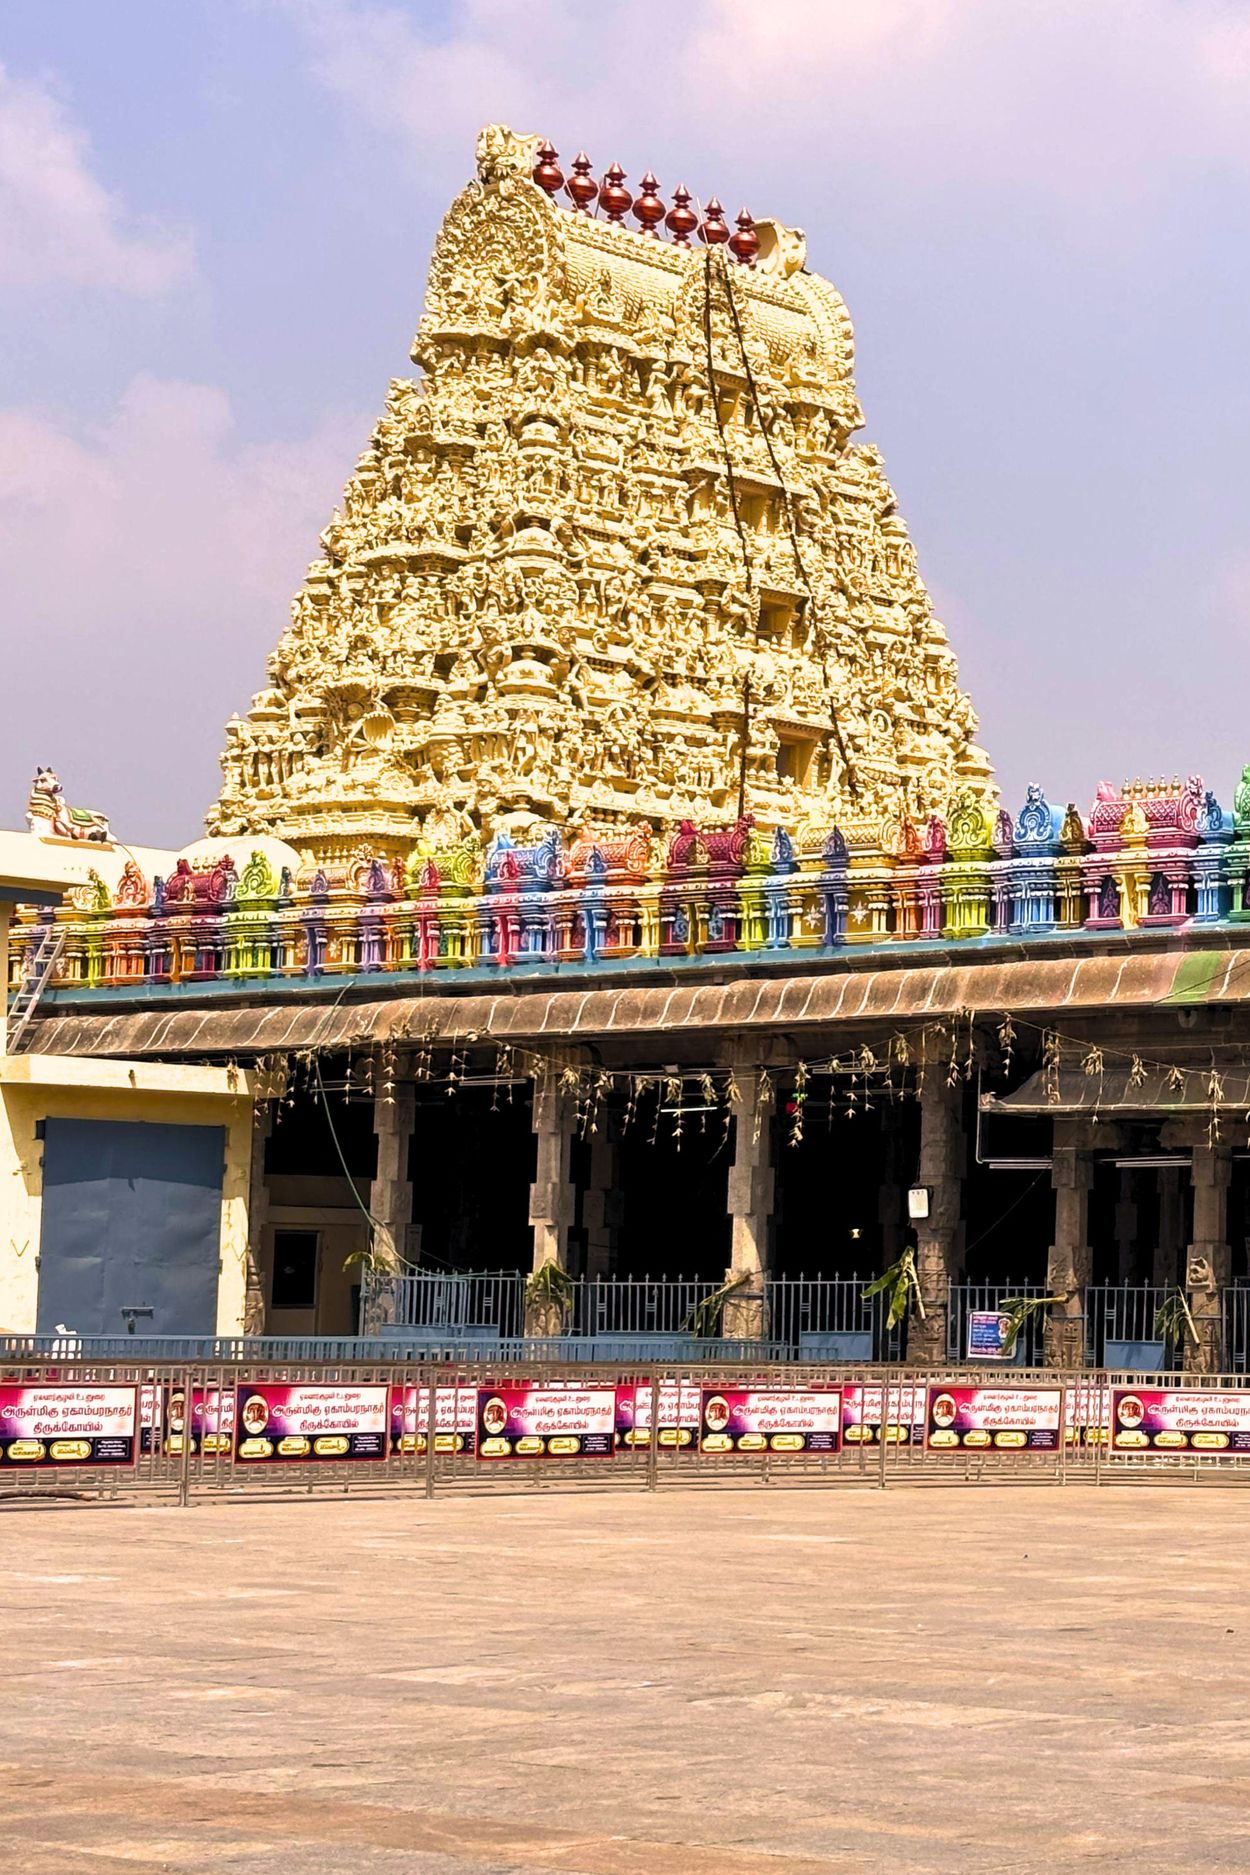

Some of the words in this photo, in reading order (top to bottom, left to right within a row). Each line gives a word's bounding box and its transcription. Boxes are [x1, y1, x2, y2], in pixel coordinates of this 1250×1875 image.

[3, 1406, 58, 1418] அருள்மிகு
[62, 1404, 132, 1418] ஏகாம்பரநாதர்
[273, 1404, 322, 1417] அருள்மிகு
[324, 1402, 384, 1416] ஏகாம்பரநாதர்
[511, 1406, 555, 1418] அருள்மிகு
[733, 1405, 777, 1416] அருள்மிகு
[960, 1402, 1002, 1413] அருள்மிகு
[1149, 1404, 1198, 1415] அருள்மிகு
[299, 1418, 359, 1432] திருக்கோயில்
[535, 1419, 589, 1432] திருக்கோயில்
[757, 1418, 814, 1429] திருக்கோயில்
[982, 1415, 1037, 1426] திருக்கோயில்
[1175, 1418, 1239, 1428] திருக்கோயில்
[33, 1421, 103, 1434] திருக்கோயில்
